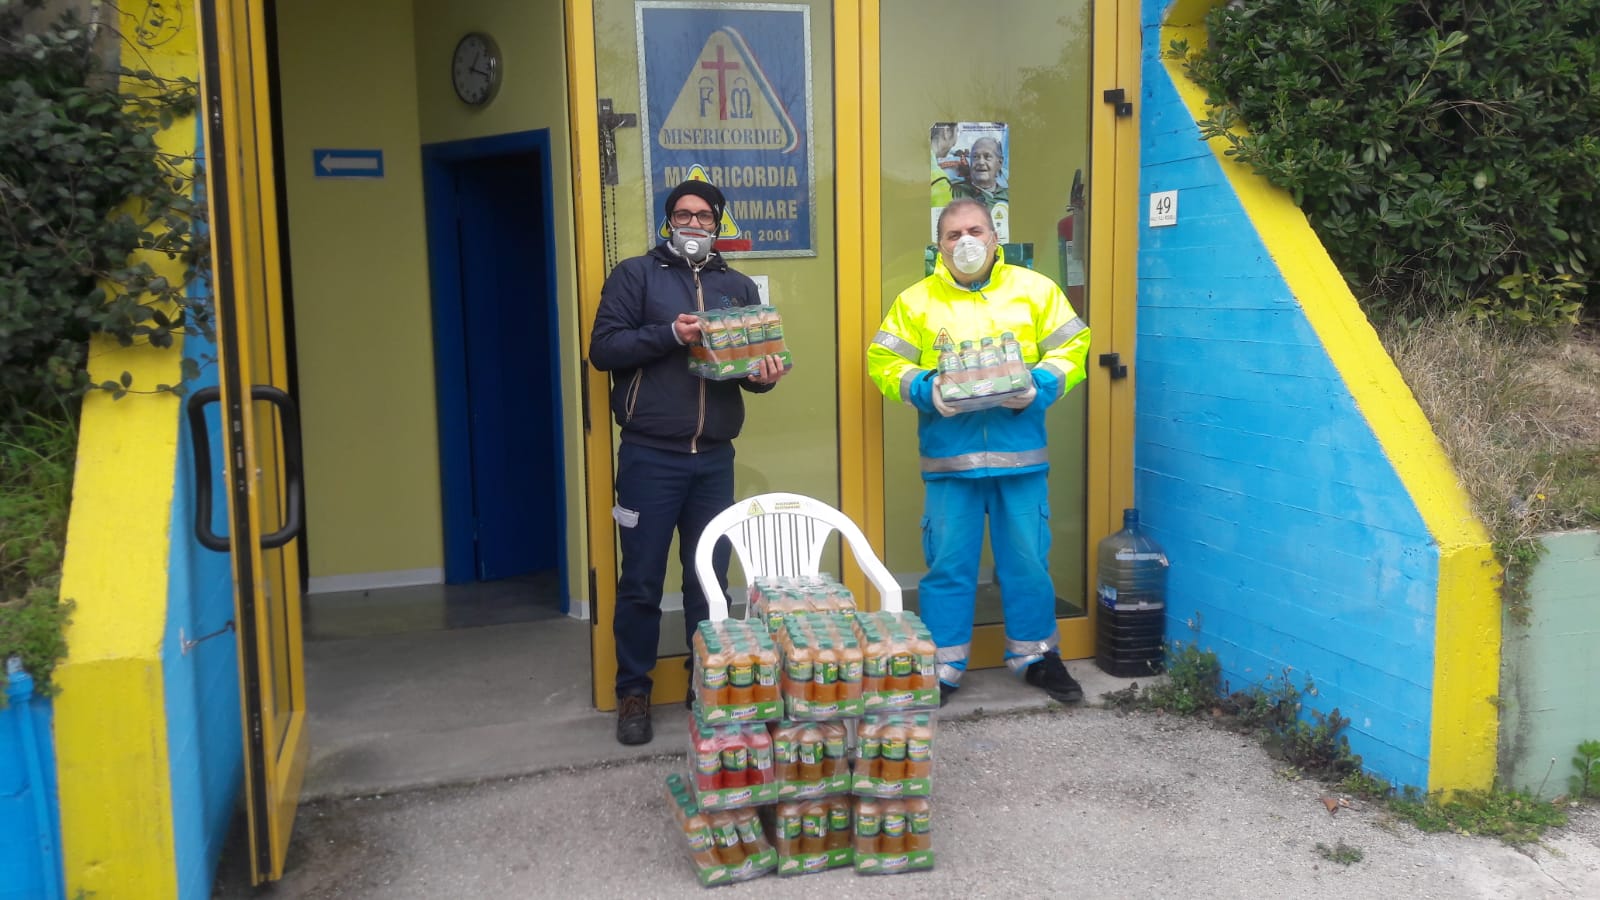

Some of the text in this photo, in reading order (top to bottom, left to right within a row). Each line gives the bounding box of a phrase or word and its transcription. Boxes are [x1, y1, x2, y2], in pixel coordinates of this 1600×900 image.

[663, 128, 783, 145] MISERICORDIE
[665, 166, 798, 188] MIRICORDIA
[1156, 196, 1171, 215] 49
[758, 229, 790, 242] 2001
